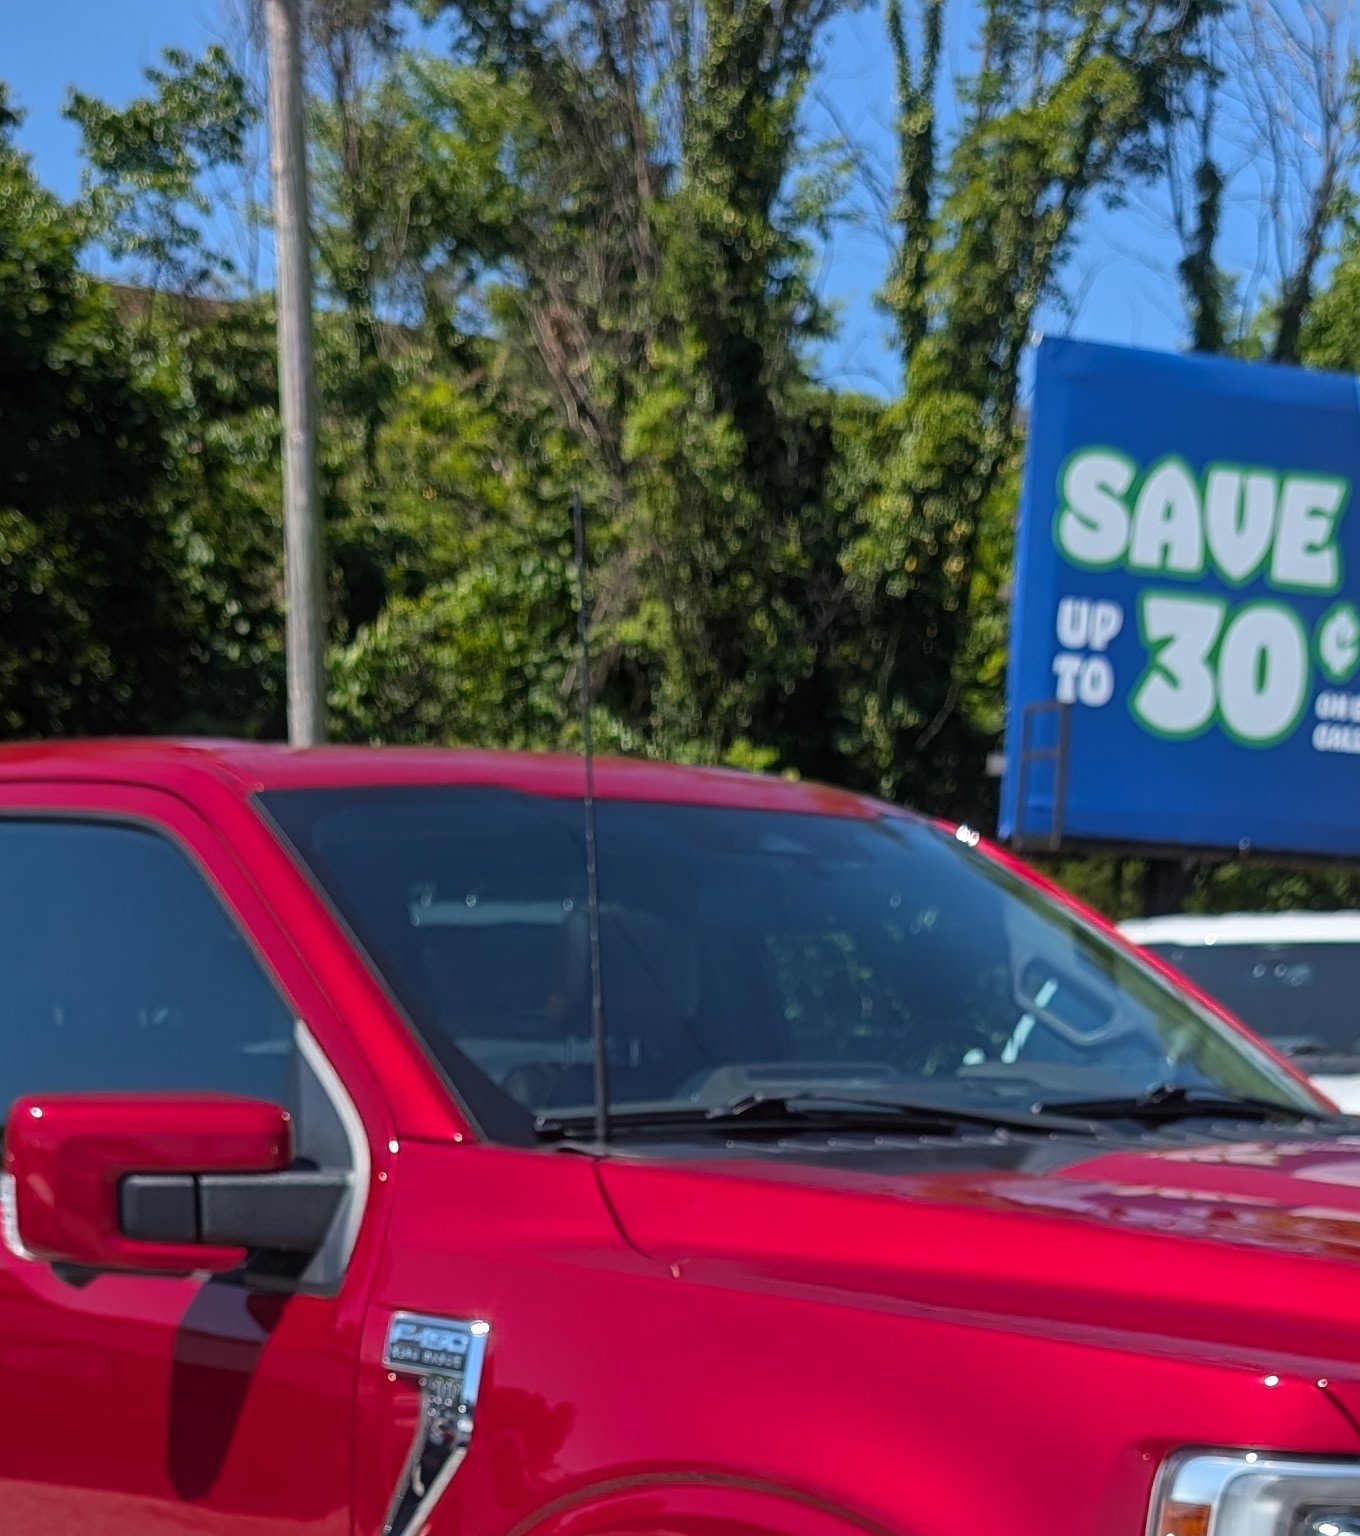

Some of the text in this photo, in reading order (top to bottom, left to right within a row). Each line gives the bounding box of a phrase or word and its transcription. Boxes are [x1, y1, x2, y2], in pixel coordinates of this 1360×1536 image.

[1055, 447, 1349, 596] SAVE
[1056, 598, 1124, 650] UP
[1052, 652, 1115, 707] TO
[1314, 690, 1349, 723] ON
